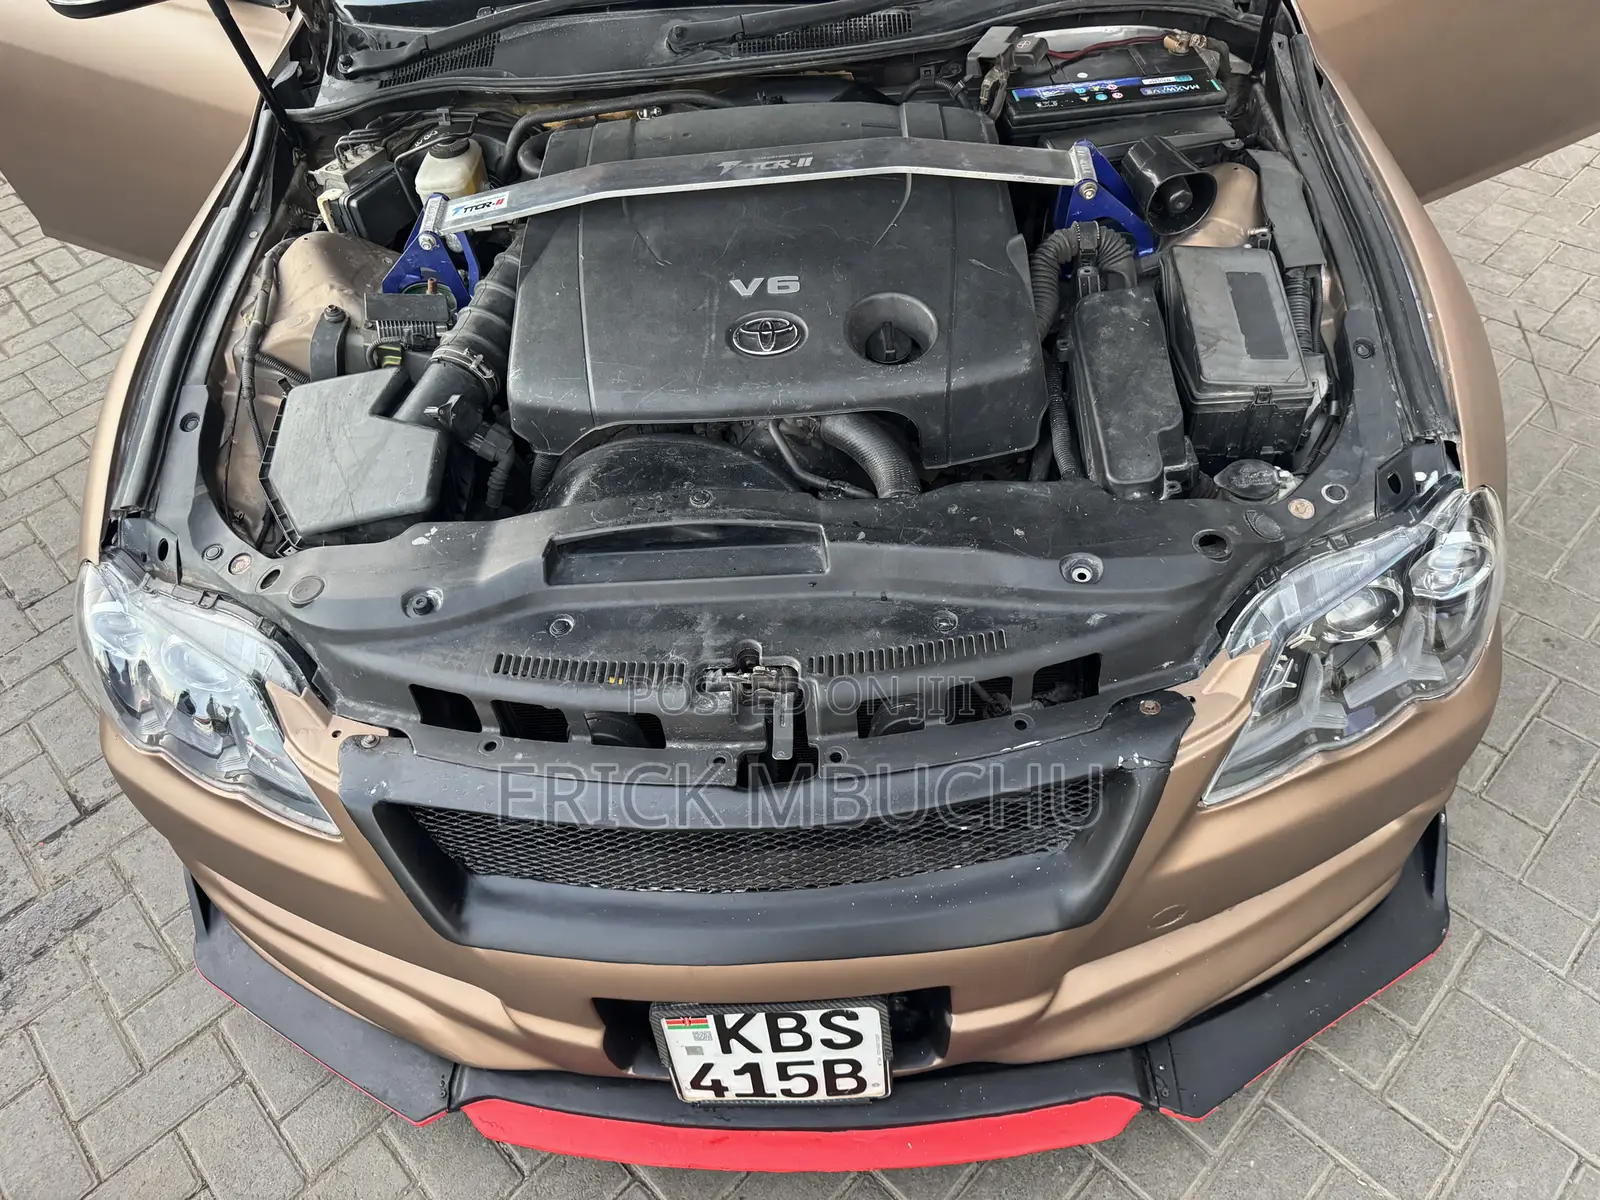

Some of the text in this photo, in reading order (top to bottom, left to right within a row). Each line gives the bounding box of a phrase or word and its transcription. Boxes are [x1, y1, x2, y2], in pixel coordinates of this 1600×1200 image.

[463, 197, 505, 214] TTCR-II
[729, 275, 801, 297] V6
[713, 1009, 864, 1055] KBS
[690, 1058, 868, 1098] 415B
